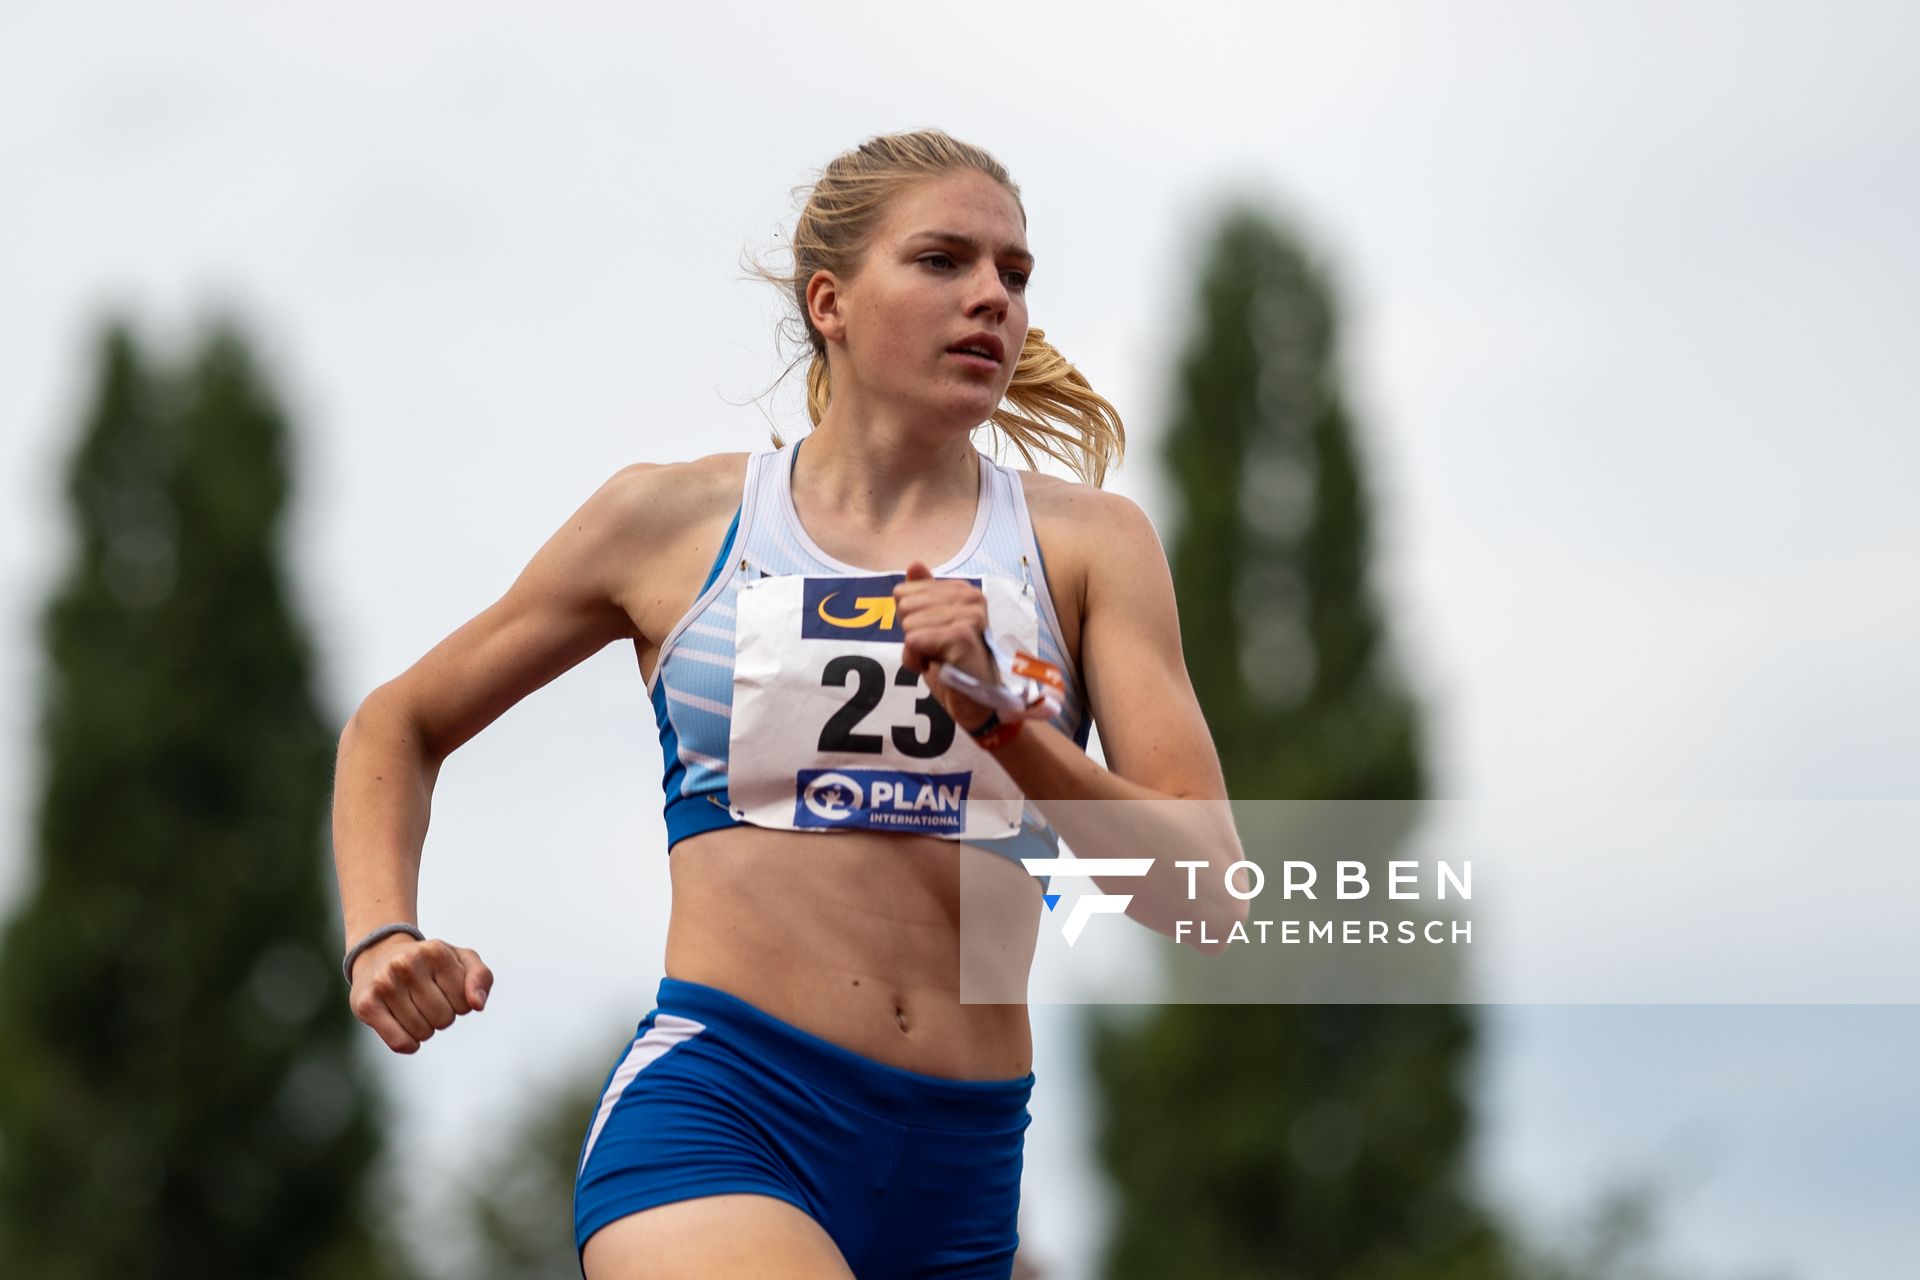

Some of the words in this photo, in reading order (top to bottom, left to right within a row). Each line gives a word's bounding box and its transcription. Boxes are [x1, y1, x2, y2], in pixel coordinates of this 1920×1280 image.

[818, 656, 956, 759] 23
[871, 782, 962, 811] PLAN
[870, 813, 959, 827] INTERNATIONAL
